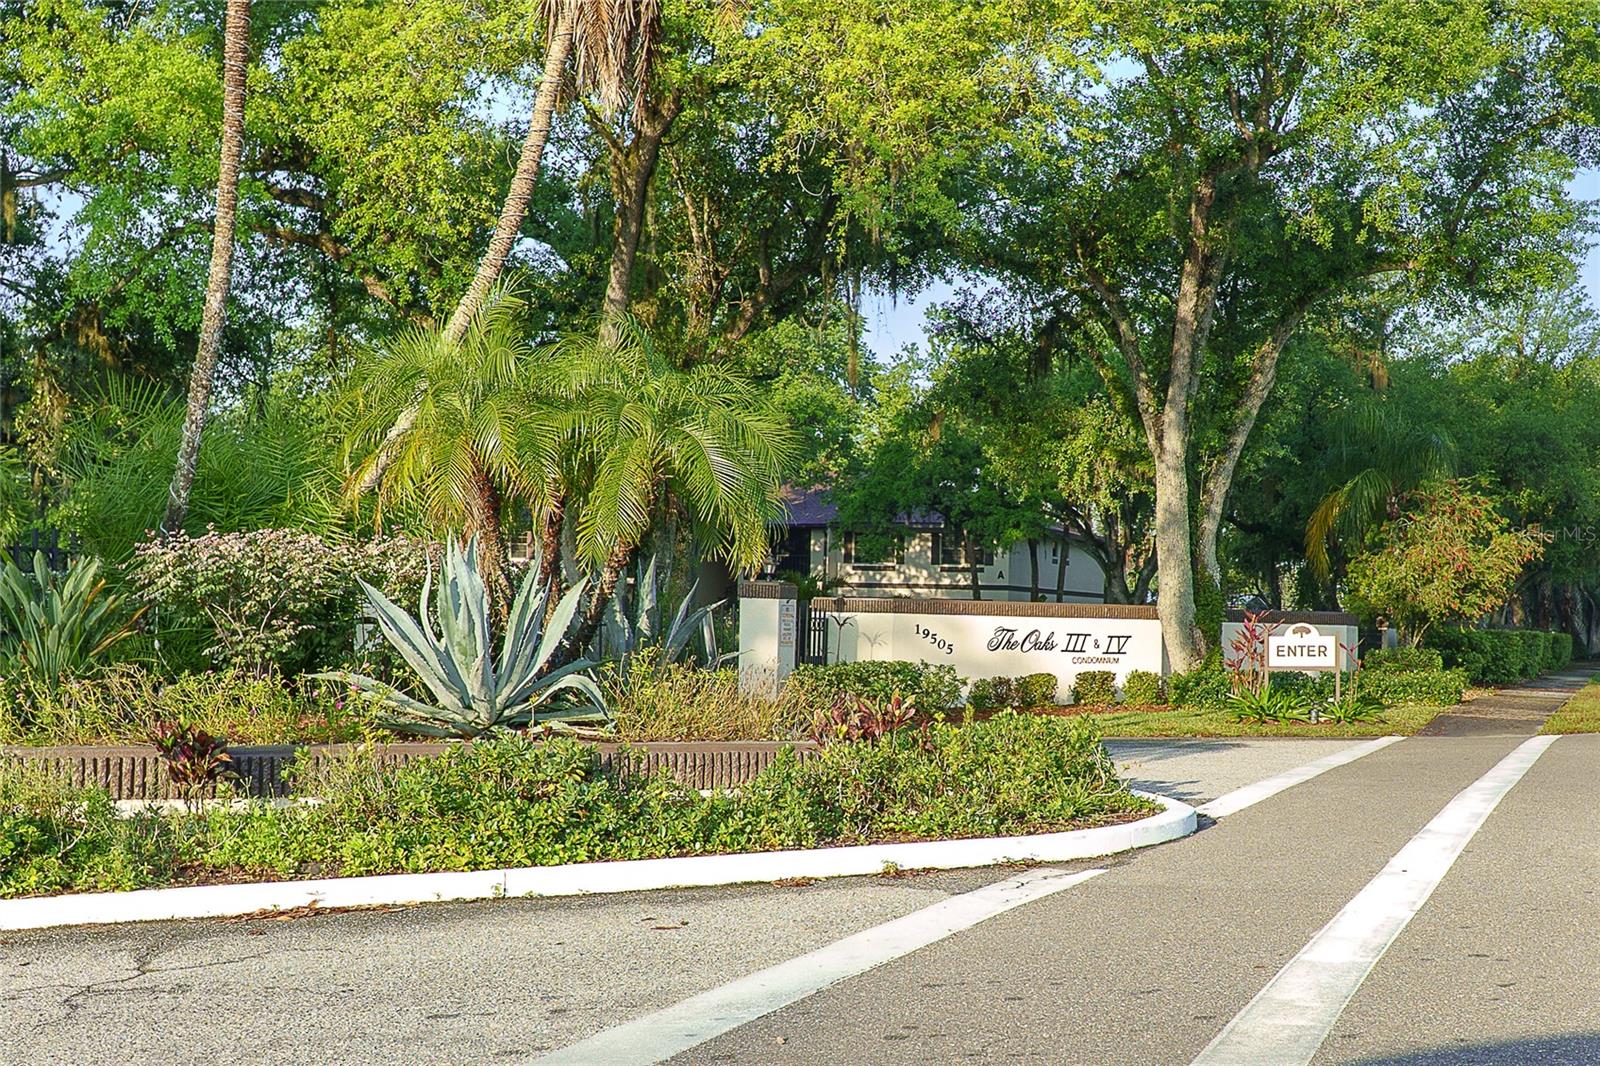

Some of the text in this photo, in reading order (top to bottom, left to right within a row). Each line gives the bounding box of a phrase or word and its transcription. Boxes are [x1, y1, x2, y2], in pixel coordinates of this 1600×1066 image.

[997, 570, 1005, 580] A
[915, 623, 954, 655] 19505
[987, 626, 1132, 655] The Oaks III & IV
[1276, 645, 1328, 657] ENTER
[1071, 656, 1120, 664] CONDOMINIUM
